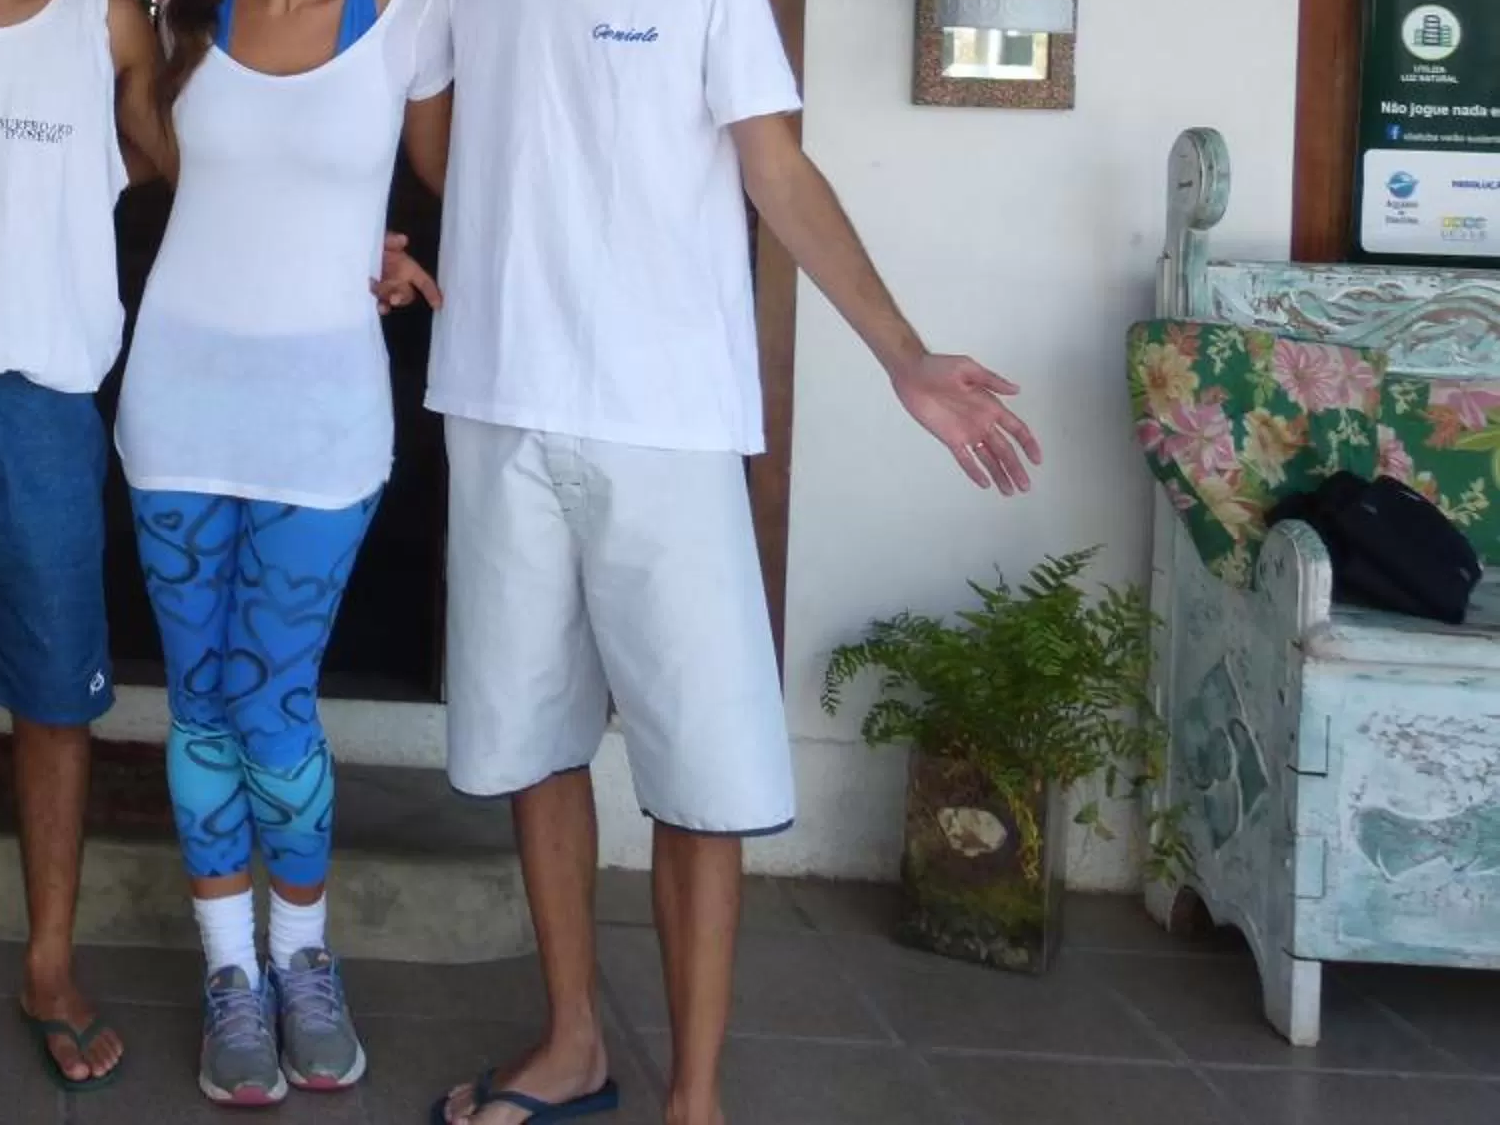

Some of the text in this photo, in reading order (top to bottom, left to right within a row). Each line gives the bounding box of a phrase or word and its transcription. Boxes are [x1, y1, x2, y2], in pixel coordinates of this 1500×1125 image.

[1381, 101, 1407, 114] Não
[1409, 102, 1449, 118] jogue
[1452, 104, 1487, 117] nada
